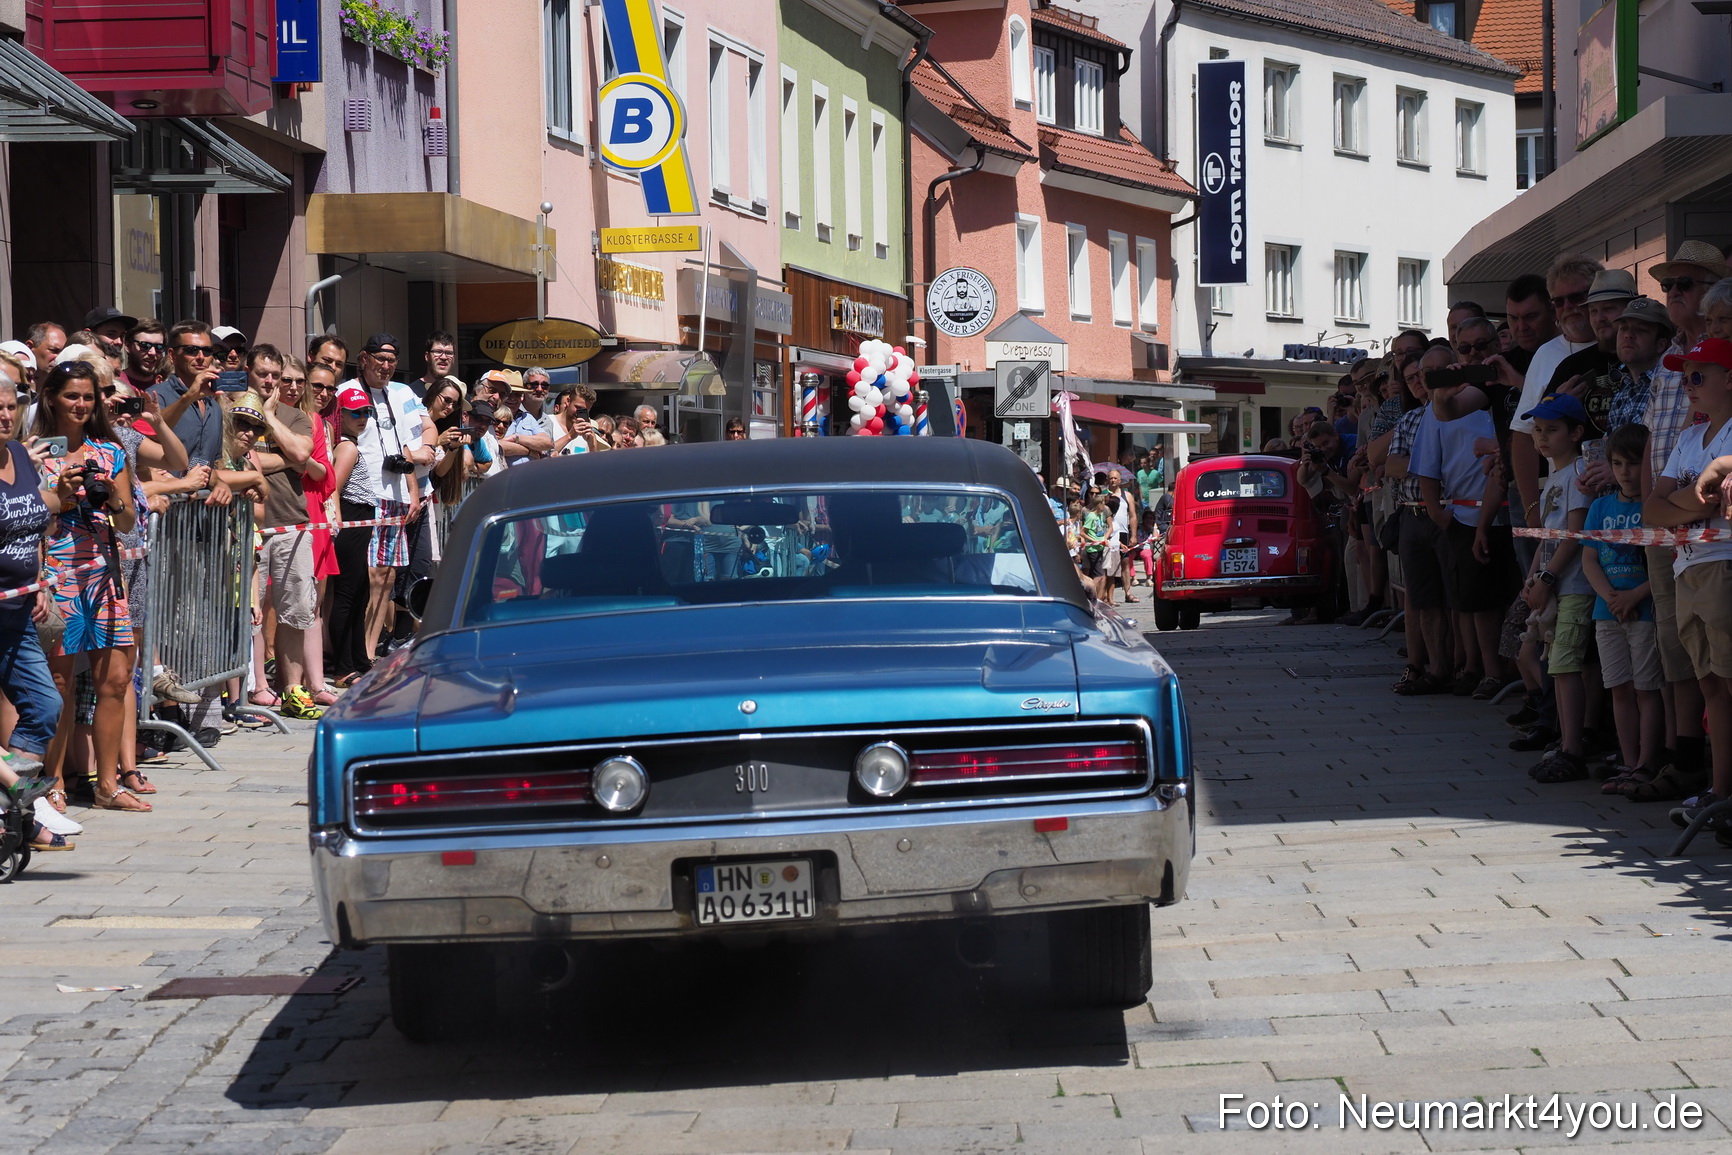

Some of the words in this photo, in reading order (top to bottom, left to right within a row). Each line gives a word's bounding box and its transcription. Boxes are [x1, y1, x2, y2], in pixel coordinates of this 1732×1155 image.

[281, 20, 308, 44] IL
[609, 97, 654, 145] B
[1229, 80, 1242, 185] TAILOR
[1230, 188, 1243, 265] TOM
[606, 233, 684, 246] KLOSTERGASSE
[687, 233, 694, 243] 4
[956, 271, 990, 295] FRISEURE
[485, 339, 506, 350] DIE
[507, 338, 600, 350] GOLDSCHMIEDE
[1284, 344, 1320, 360] TOM
[919, 367, 952, 376] Klostergasse
[1203, 490, 1215, 498] 60
[1, 501, 47, 520] Sunshine
[1228, 549, 1243, 561] SC
[1223, 561, 1231, 573] F
[1233, 560, 1256, 572] 574
[735, 764, 769, 792] 300
[717, 866, 753, 892] HN
